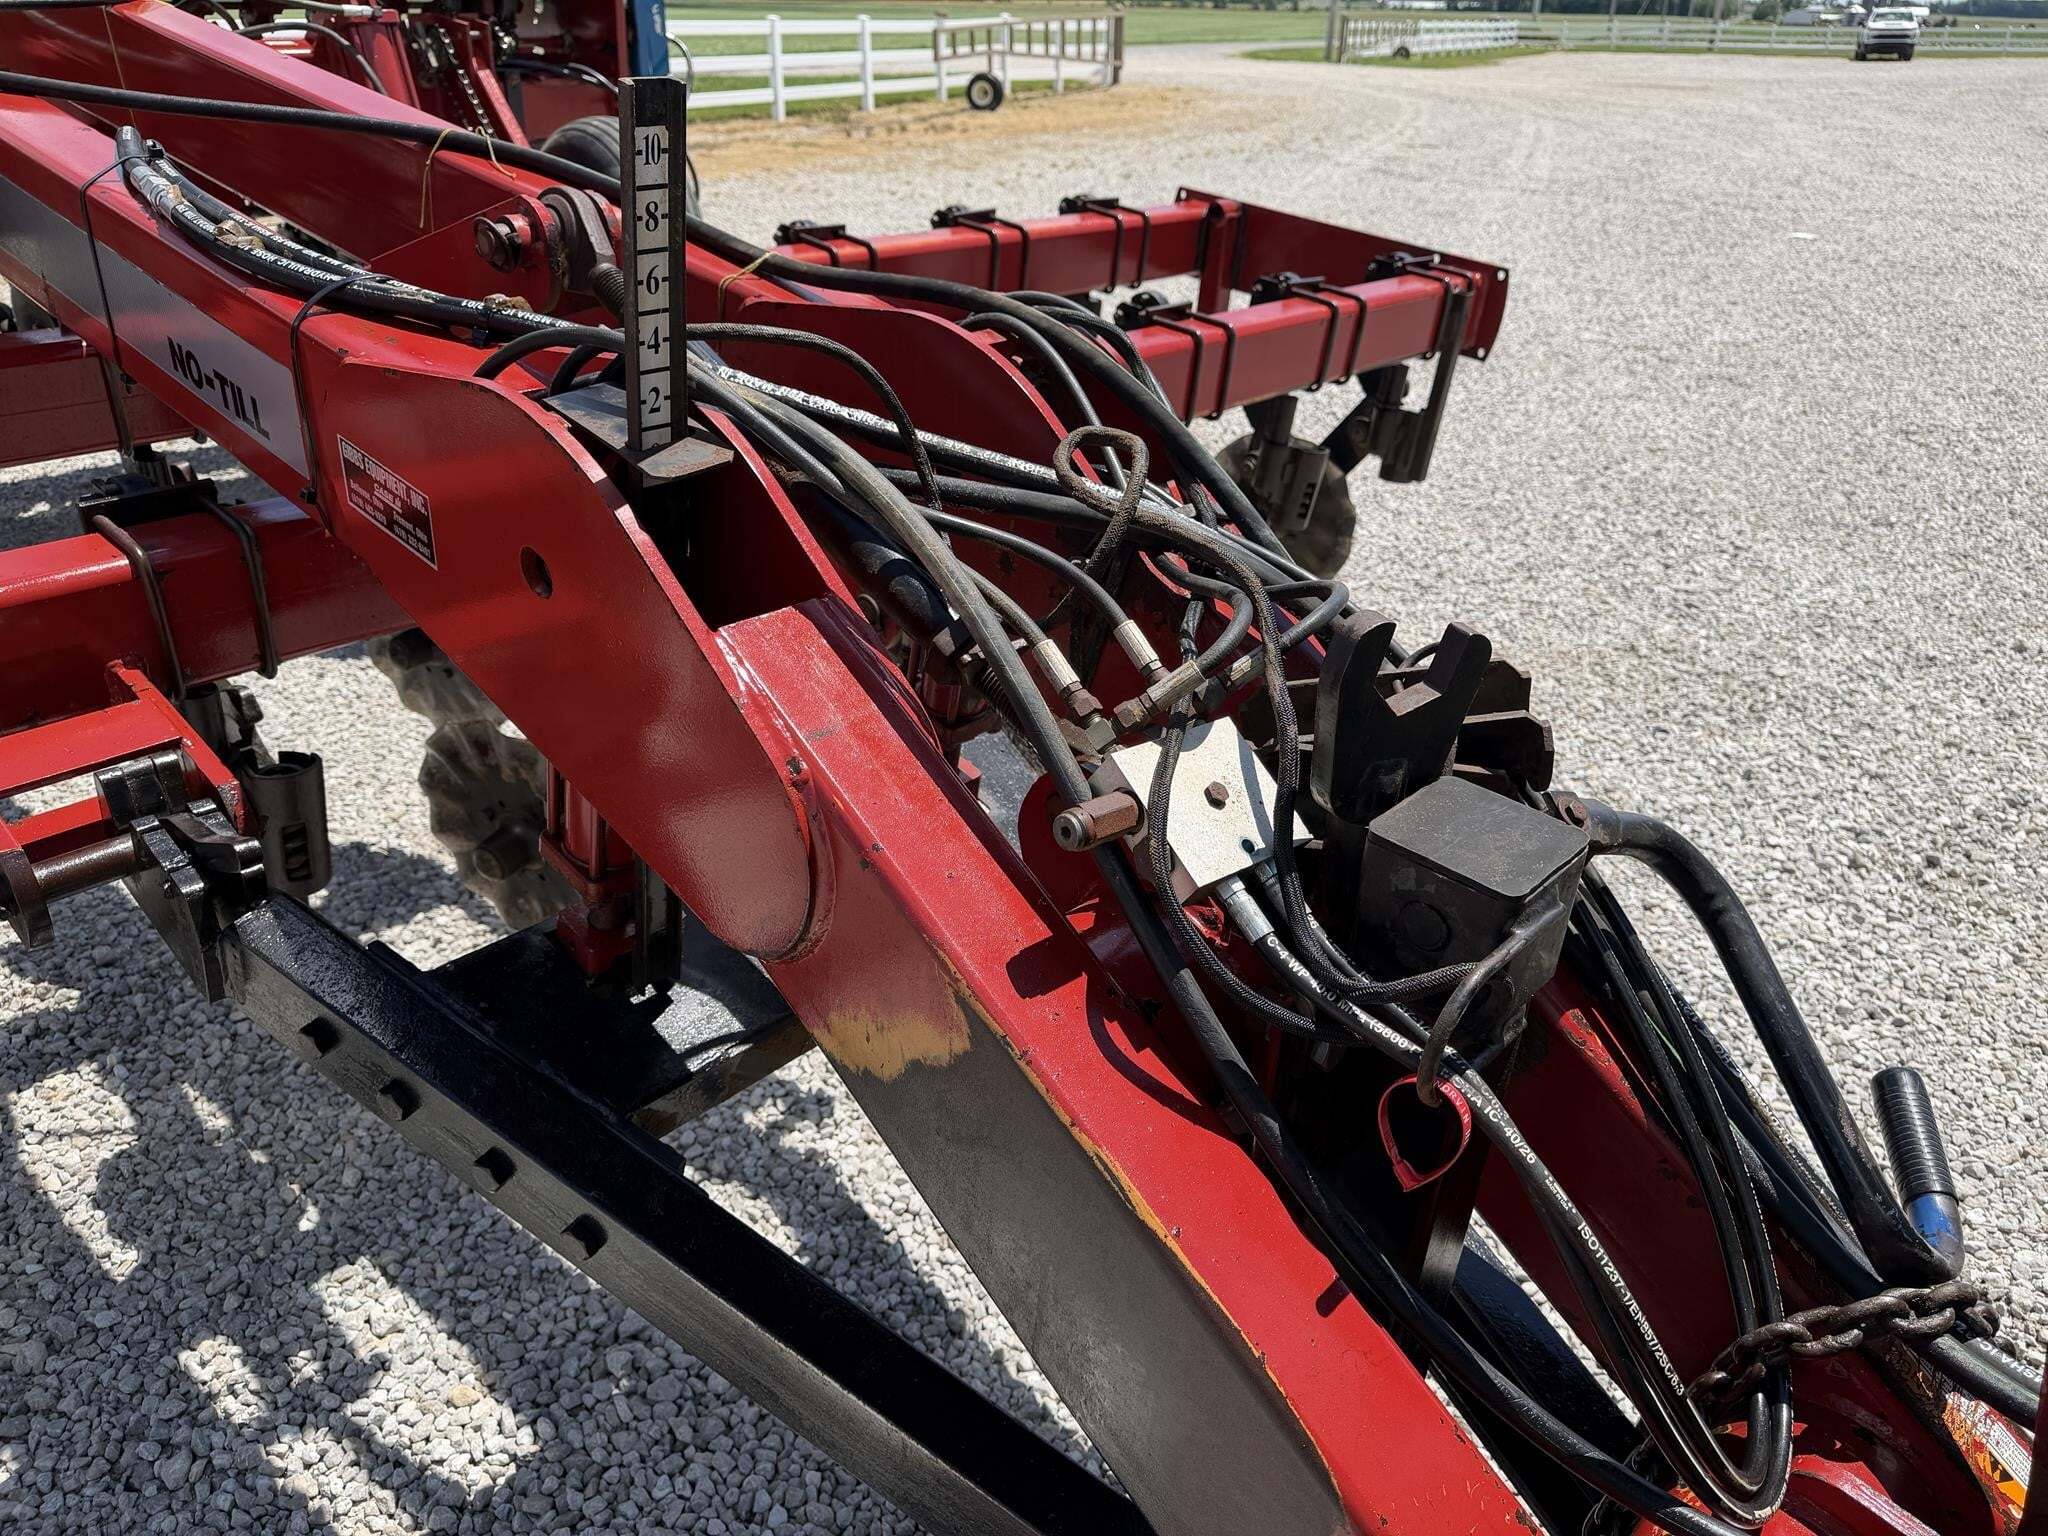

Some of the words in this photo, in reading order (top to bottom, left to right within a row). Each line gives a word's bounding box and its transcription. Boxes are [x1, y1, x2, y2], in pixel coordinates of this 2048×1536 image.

[642, 132, 661, 167] 10
[644, 200, 660, 233] 8
[250, 247, 276, 262] HOSE
[277, 257, 331, 281] HYDRAULIC
[645, 264, 660, 296] 6
[646, 325, 661, 356] 4
[167, 335, 271, 441] NO-TILL
[647, 385, 662, 415] 2
[364, 457, 411, 506] EQUIPMENT,
[410, 488, 428, 517] INC.
[374, 483, 395, 503] CASE
[1288, 957, 1311, 978] WP
[1483, 1105, 1536, 1165] IC-40/26
